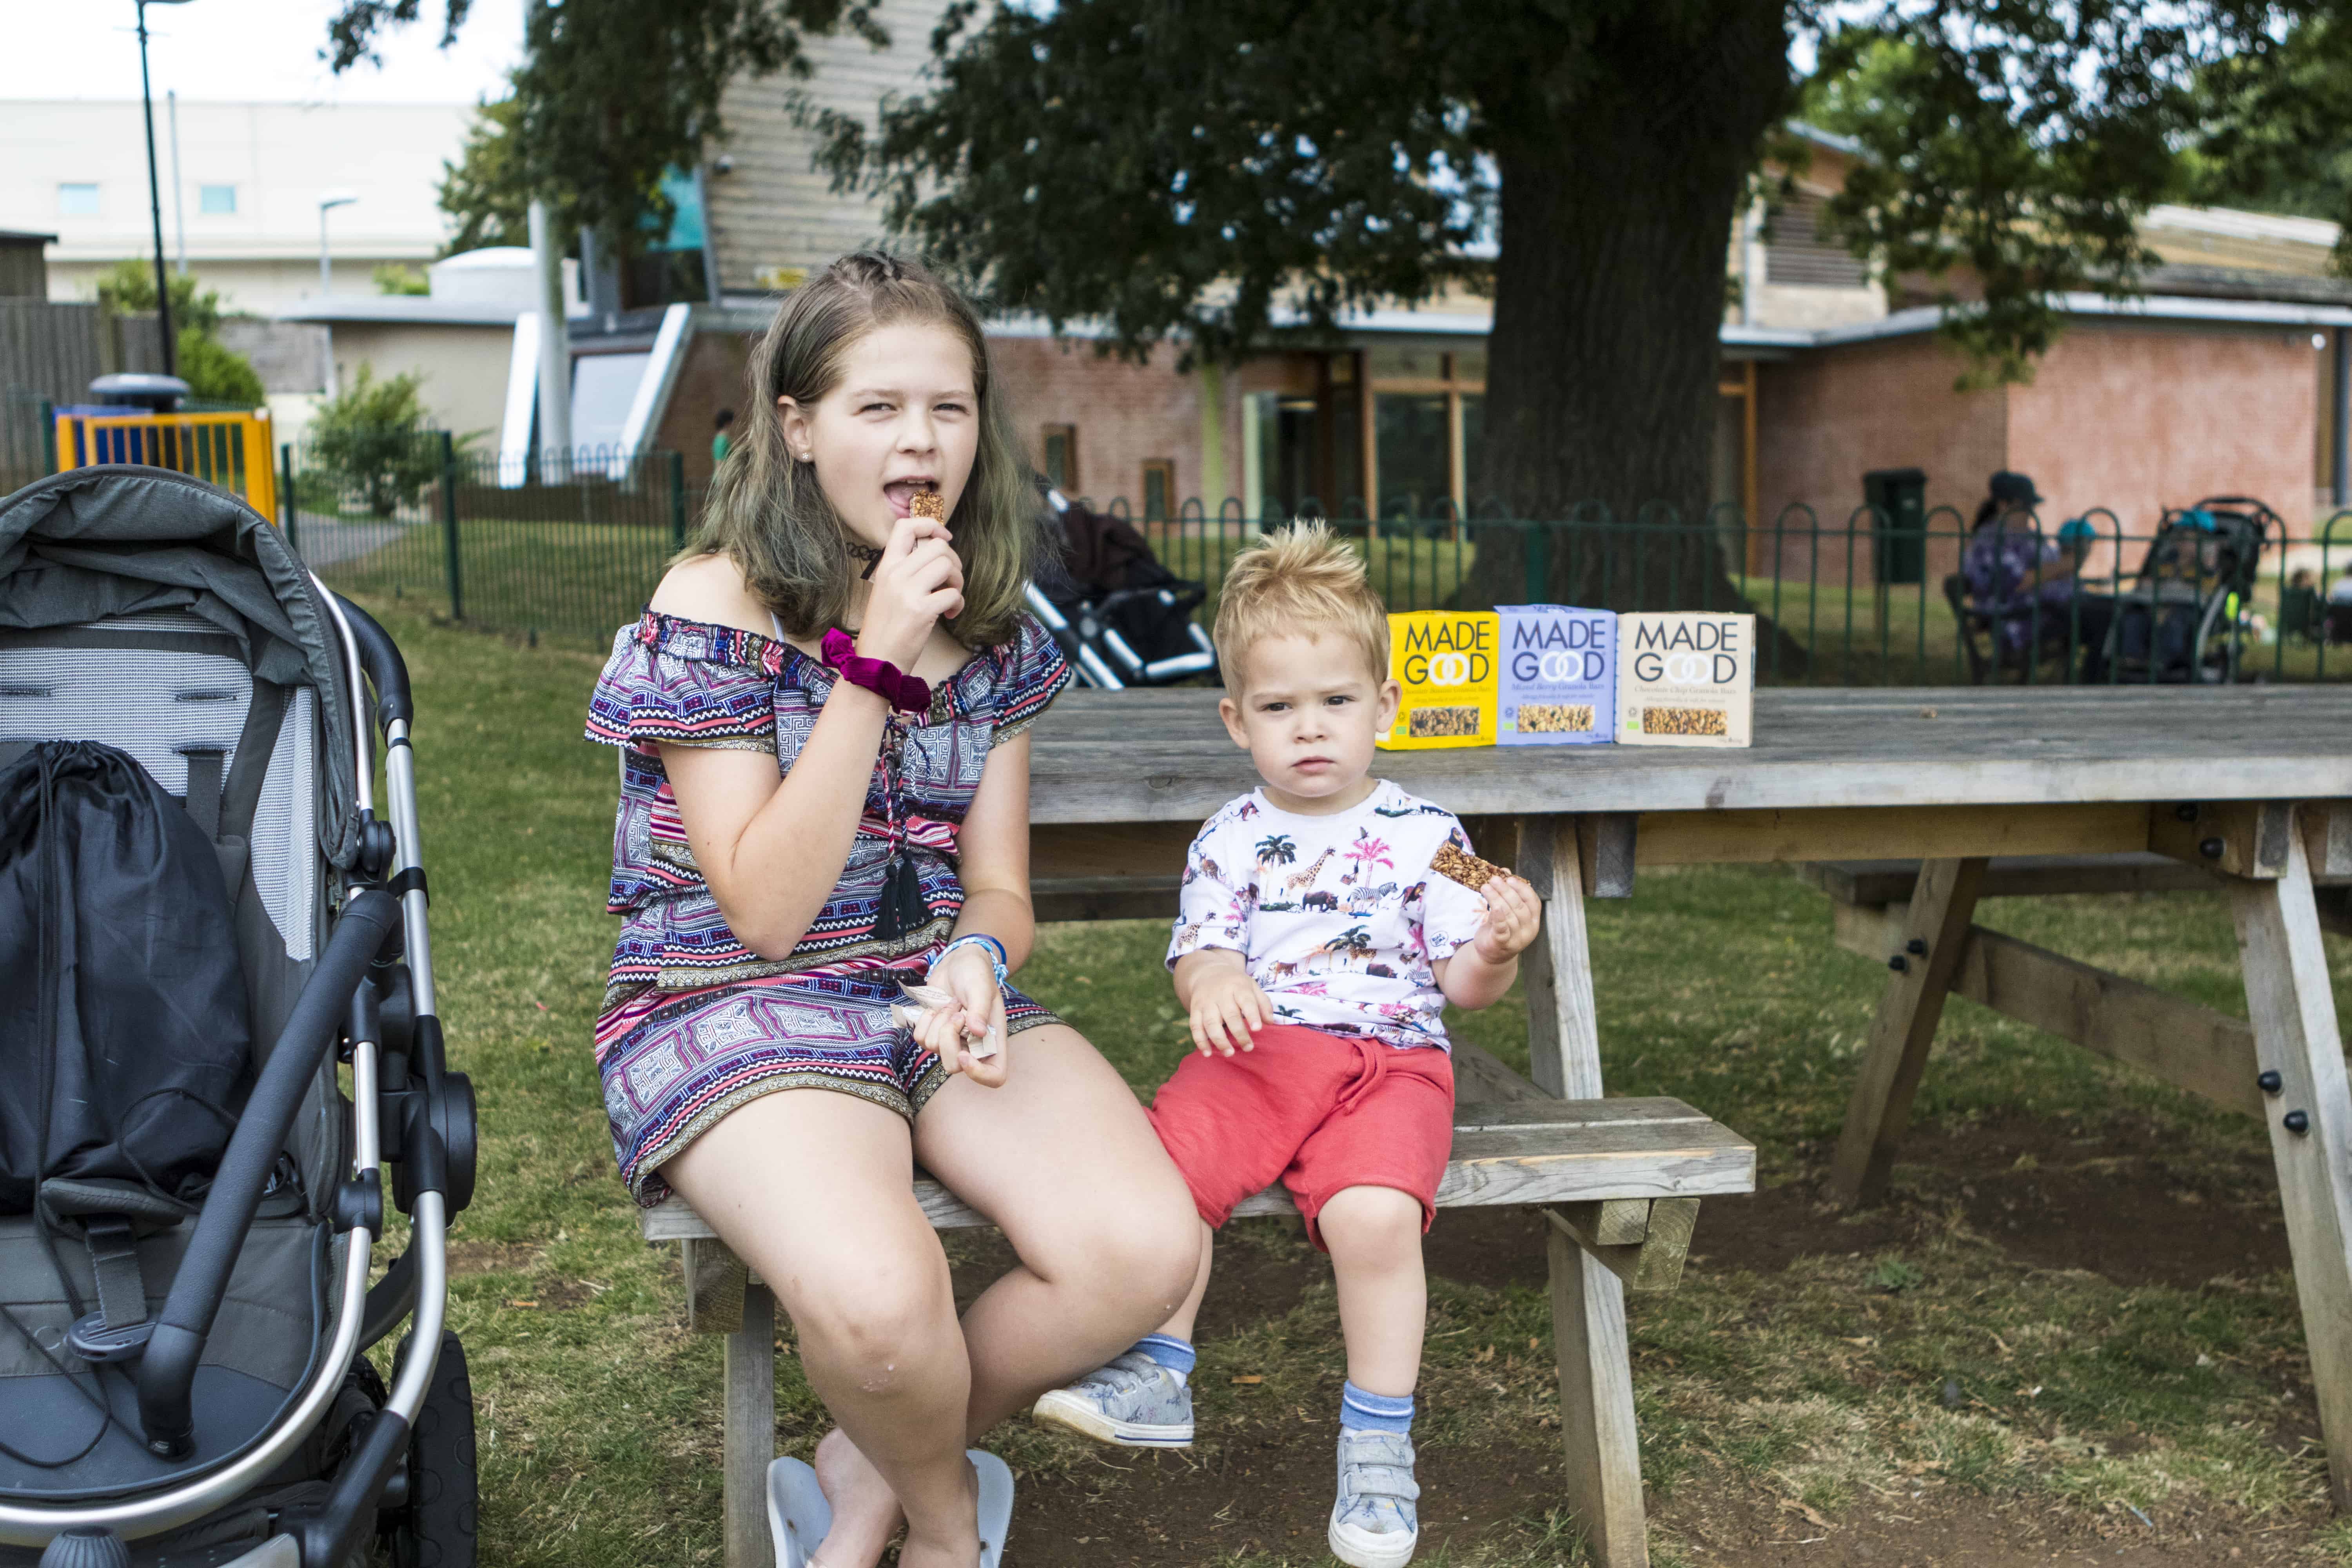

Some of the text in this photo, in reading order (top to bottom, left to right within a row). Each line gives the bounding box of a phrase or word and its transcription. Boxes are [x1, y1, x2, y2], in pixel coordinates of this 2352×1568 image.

[1405, 621, 1490, 652] MADE
[1512, 619, 1605, 649] MADE
[1635, 620, 1738, 651] MADE
[1404, 653, 1489, 685] GOOD
[1512, 651, 1605, 682] GOOD
[1634, 652, 1737, 684] GOOD
